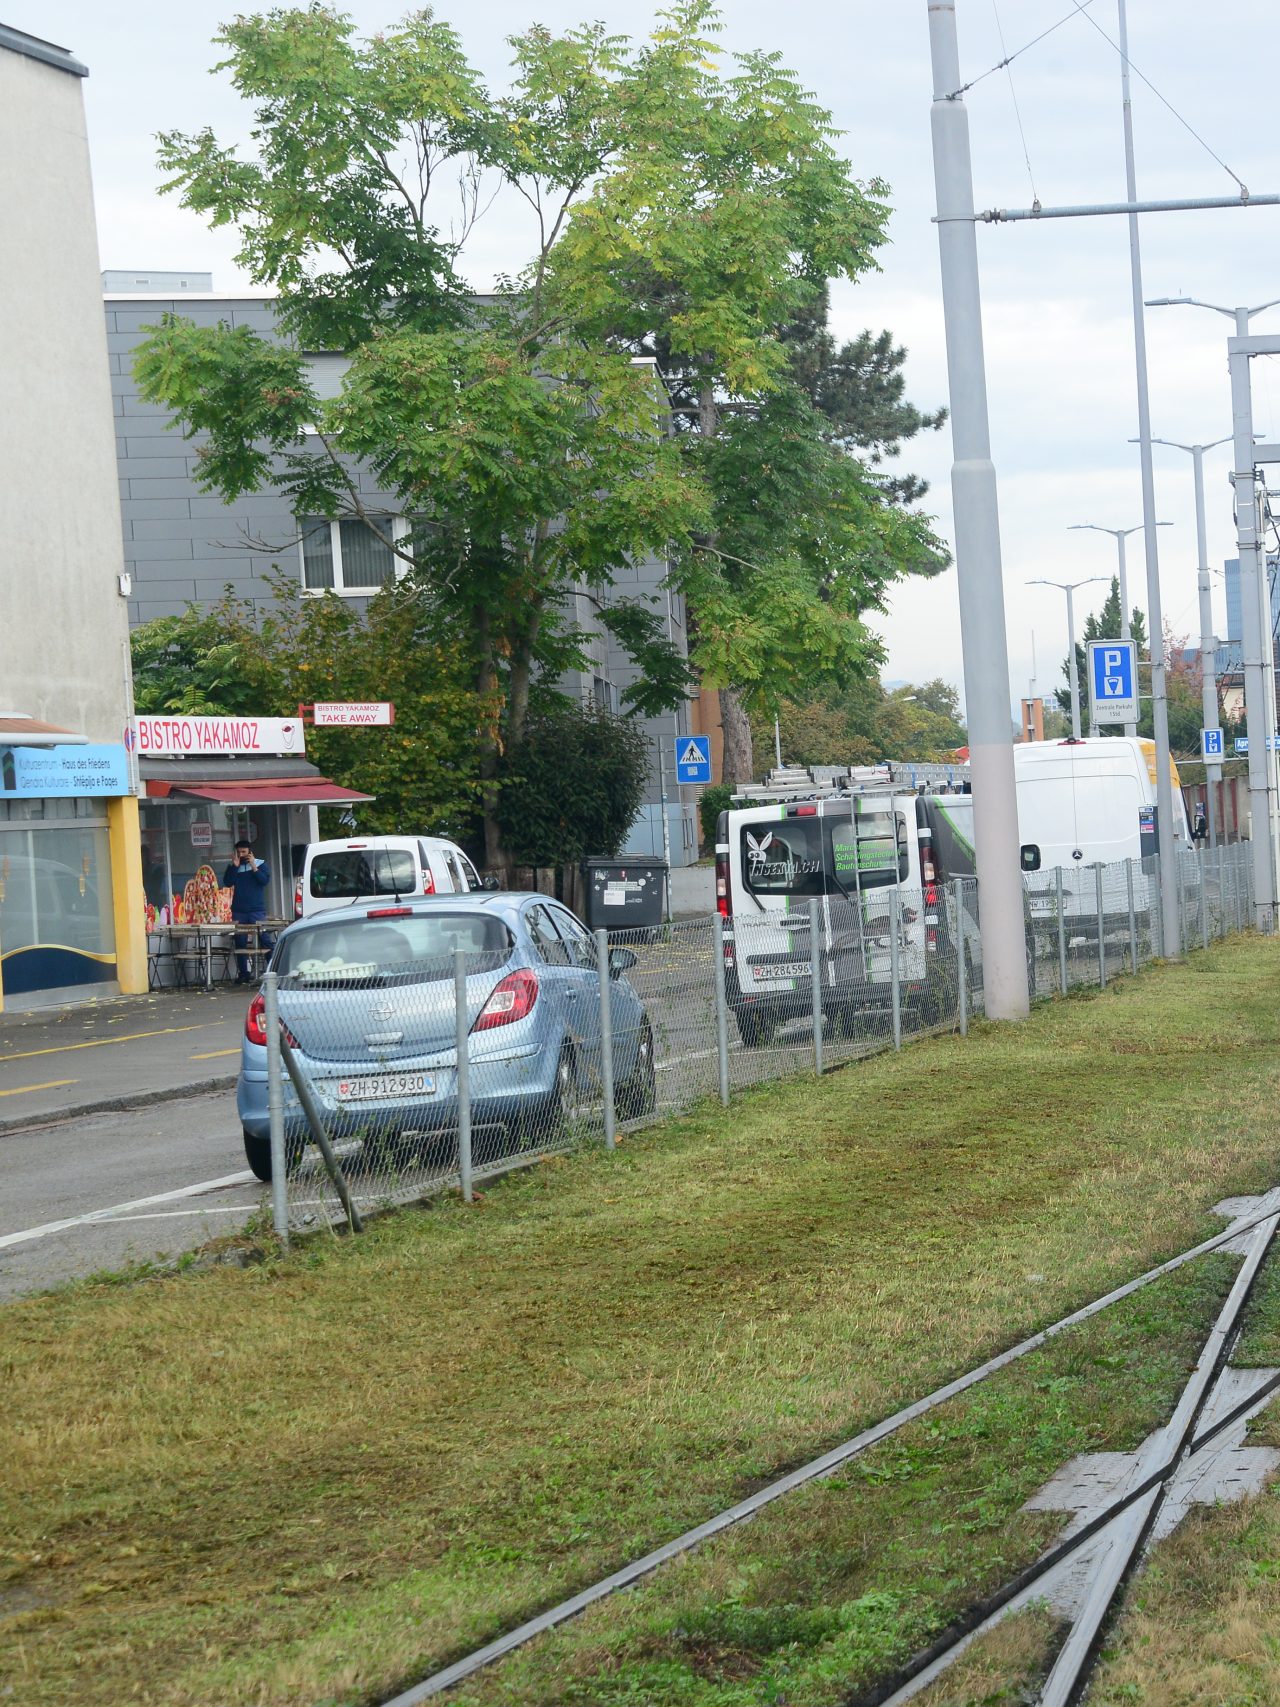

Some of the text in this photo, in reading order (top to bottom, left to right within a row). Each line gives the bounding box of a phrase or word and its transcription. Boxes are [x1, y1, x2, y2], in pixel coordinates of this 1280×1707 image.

[1104, 650, 1121, 676] P
[321, 714, 377, 723] TAKE AWAY
[139, 721, 261, 749] BISTRO YAKAMOZ
